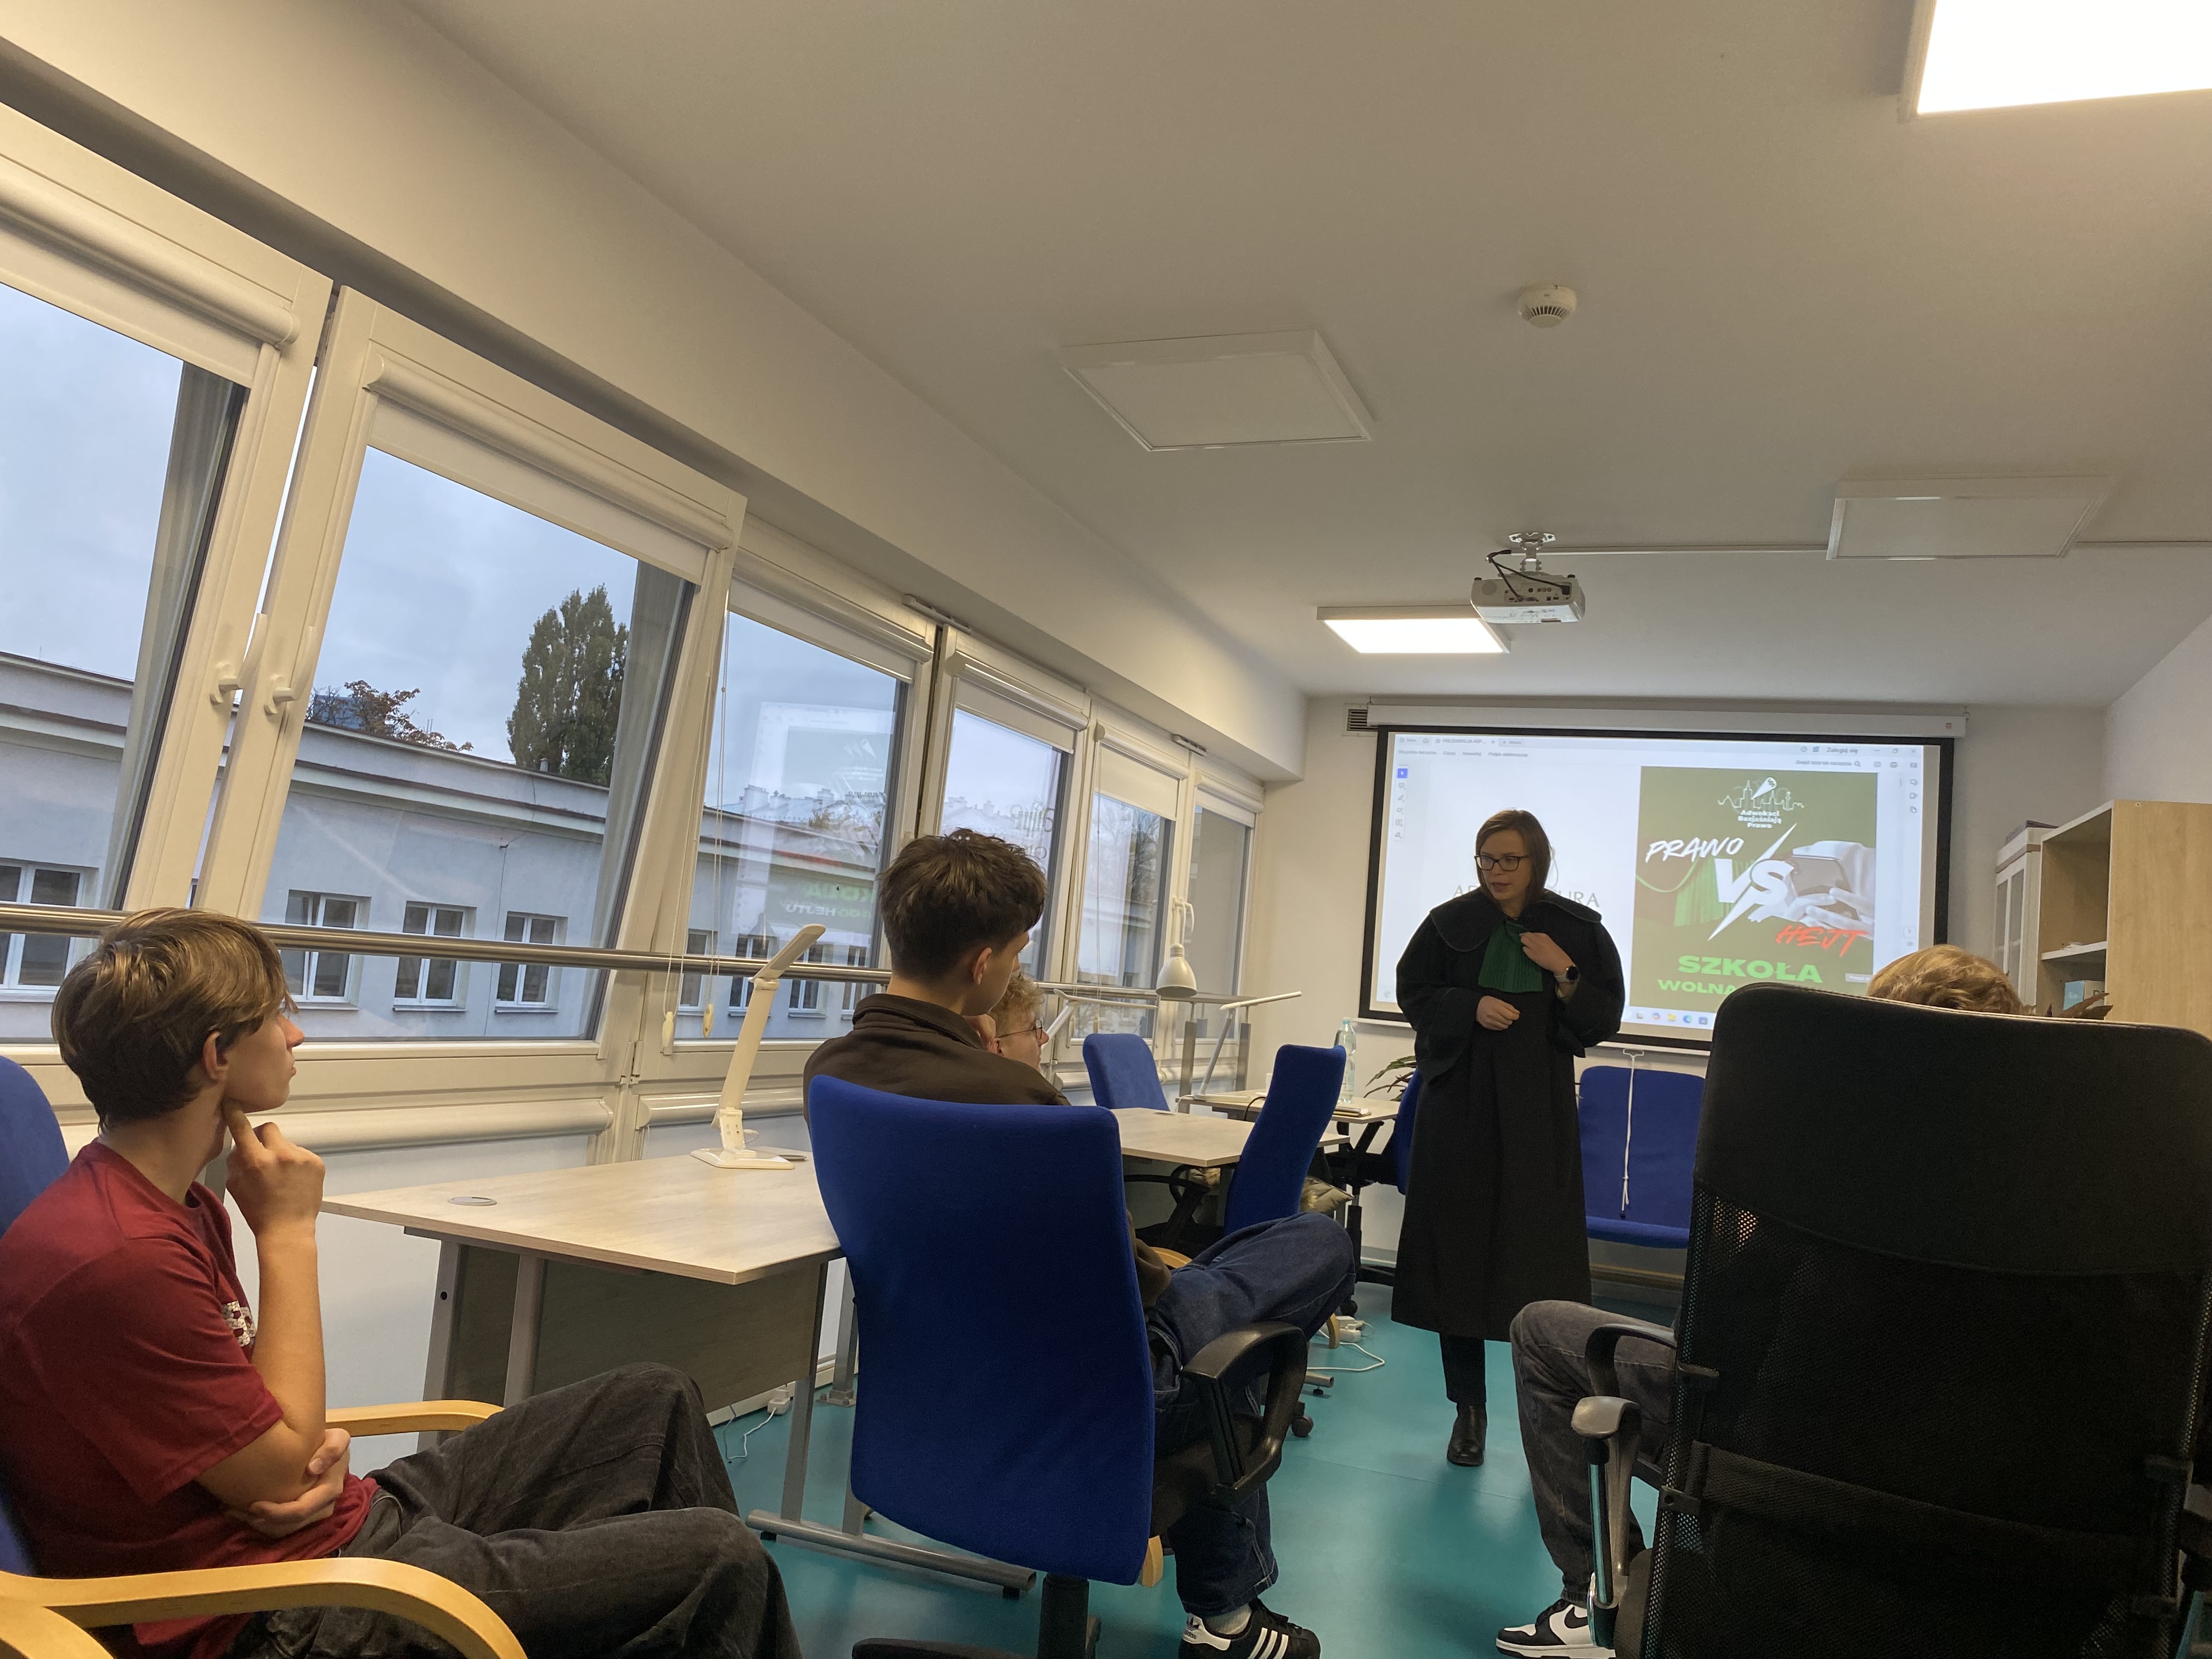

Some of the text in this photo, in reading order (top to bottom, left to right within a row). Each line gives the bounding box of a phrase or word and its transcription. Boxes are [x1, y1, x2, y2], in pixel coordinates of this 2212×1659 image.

[1737, 815, 1782, 824] Rozjaśniają
[1645, 837, 1745, 863] PRAWO
[1714, 858, 1795, 906] VS
[1775, 924, 1869, 957] HEJT
[1678, 955, 1822, 983] SZKOŁA
[1657, 979, 1737, 995] WOLNA
